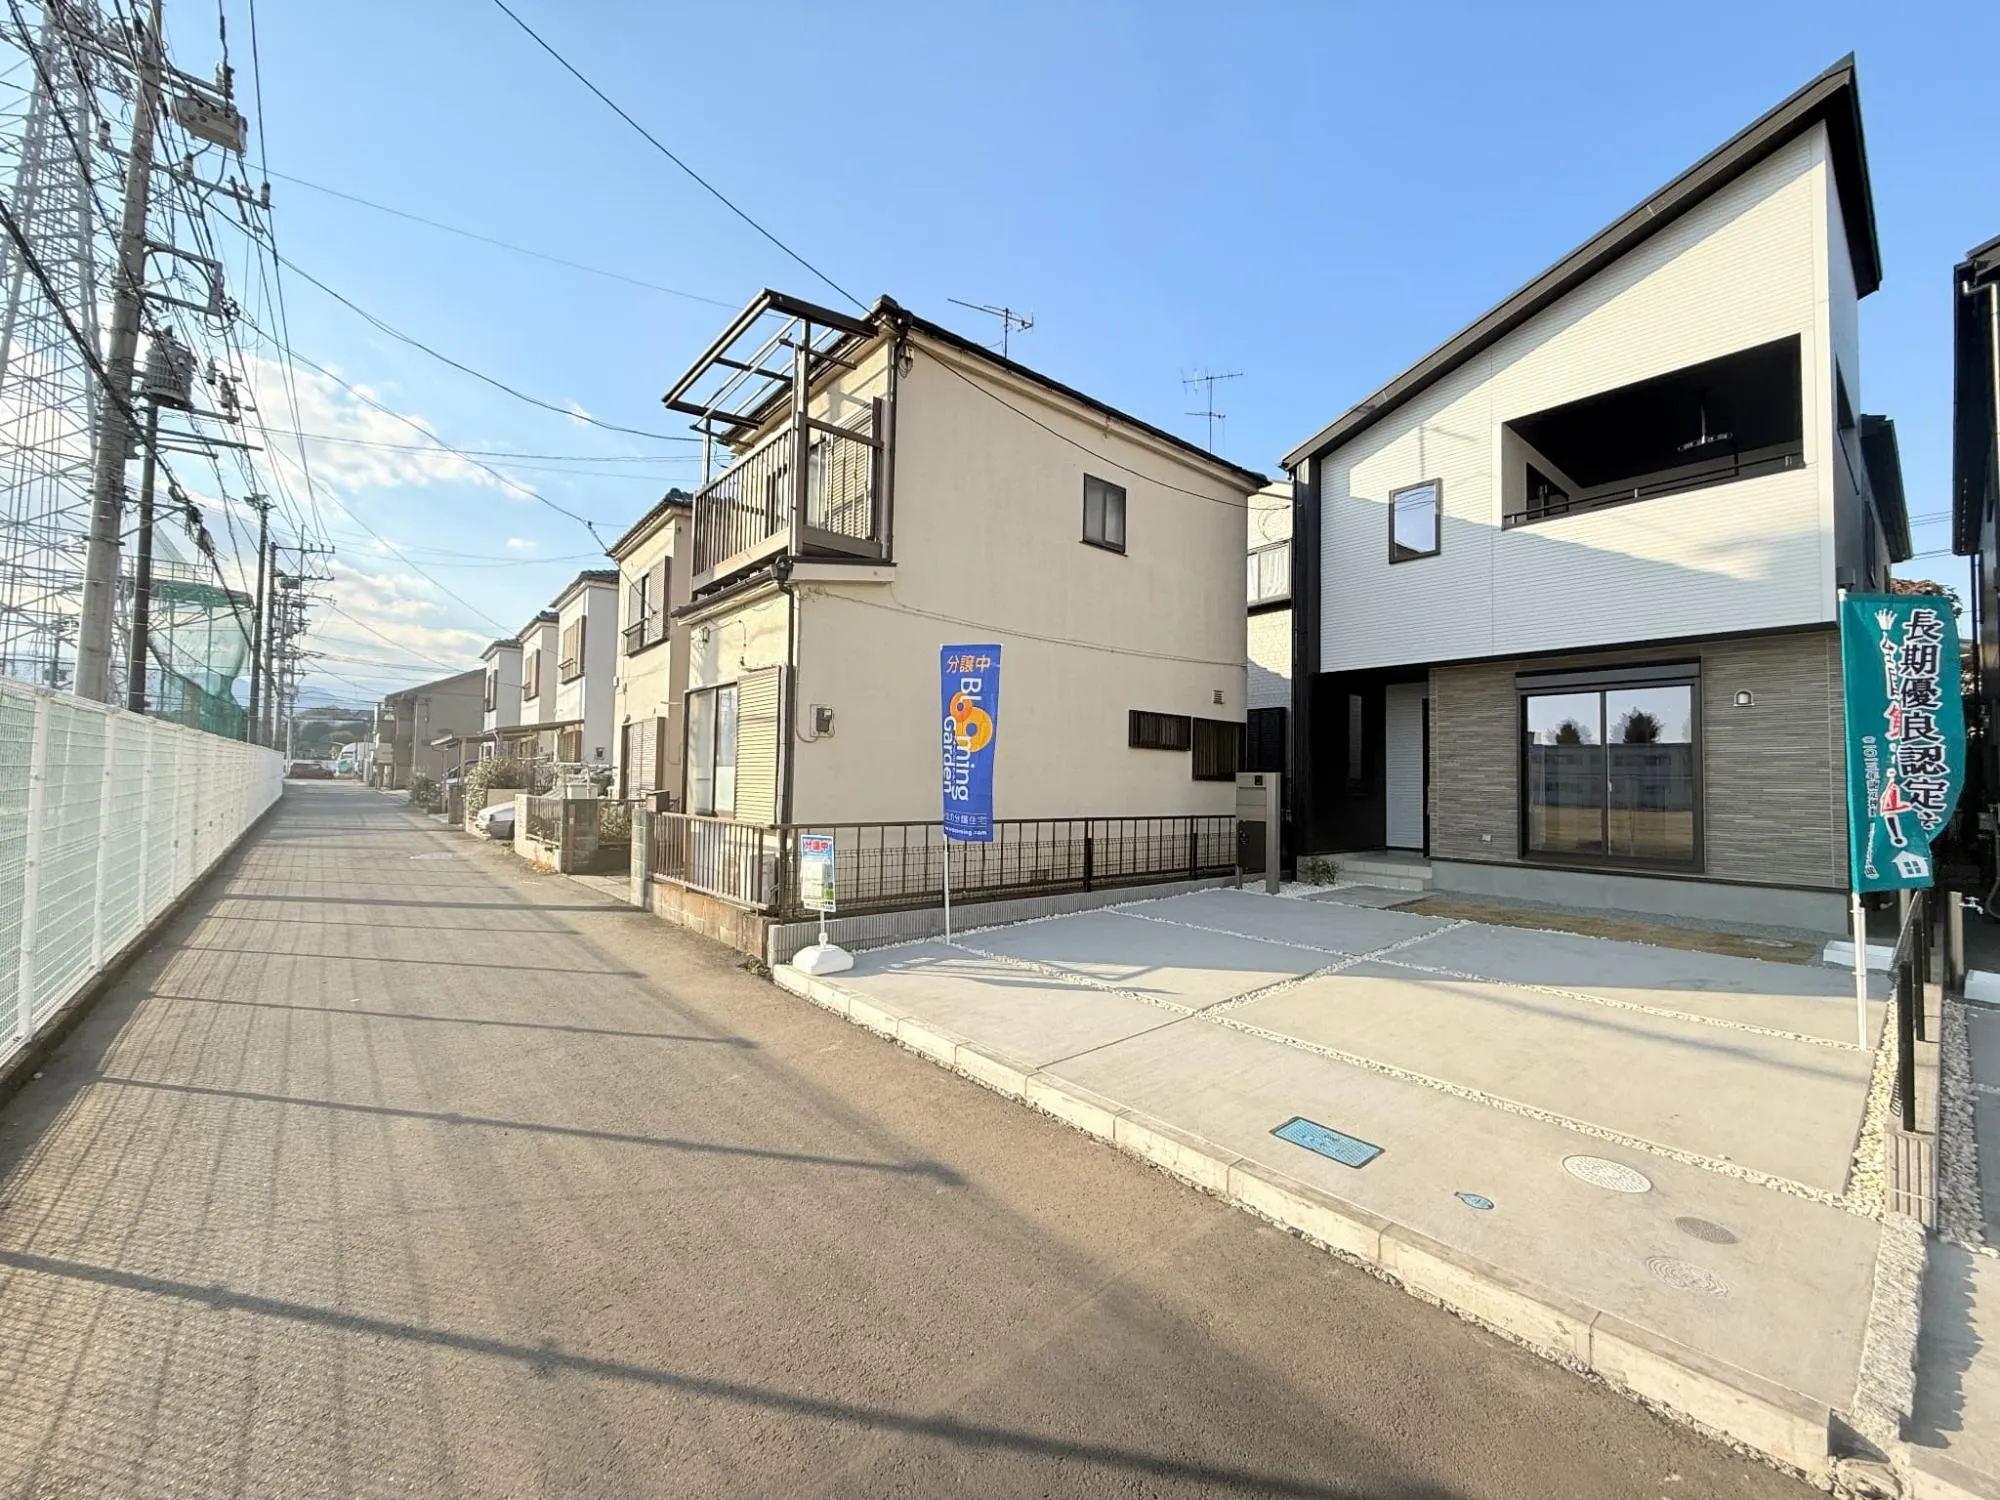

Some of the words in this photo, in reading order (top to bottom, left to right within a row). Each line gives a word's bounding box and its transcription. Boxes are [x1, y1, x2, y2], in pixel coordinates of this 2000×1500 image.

[946, 655, 991, 674] 分譲中
[943, 716, 957, 793] Garden
